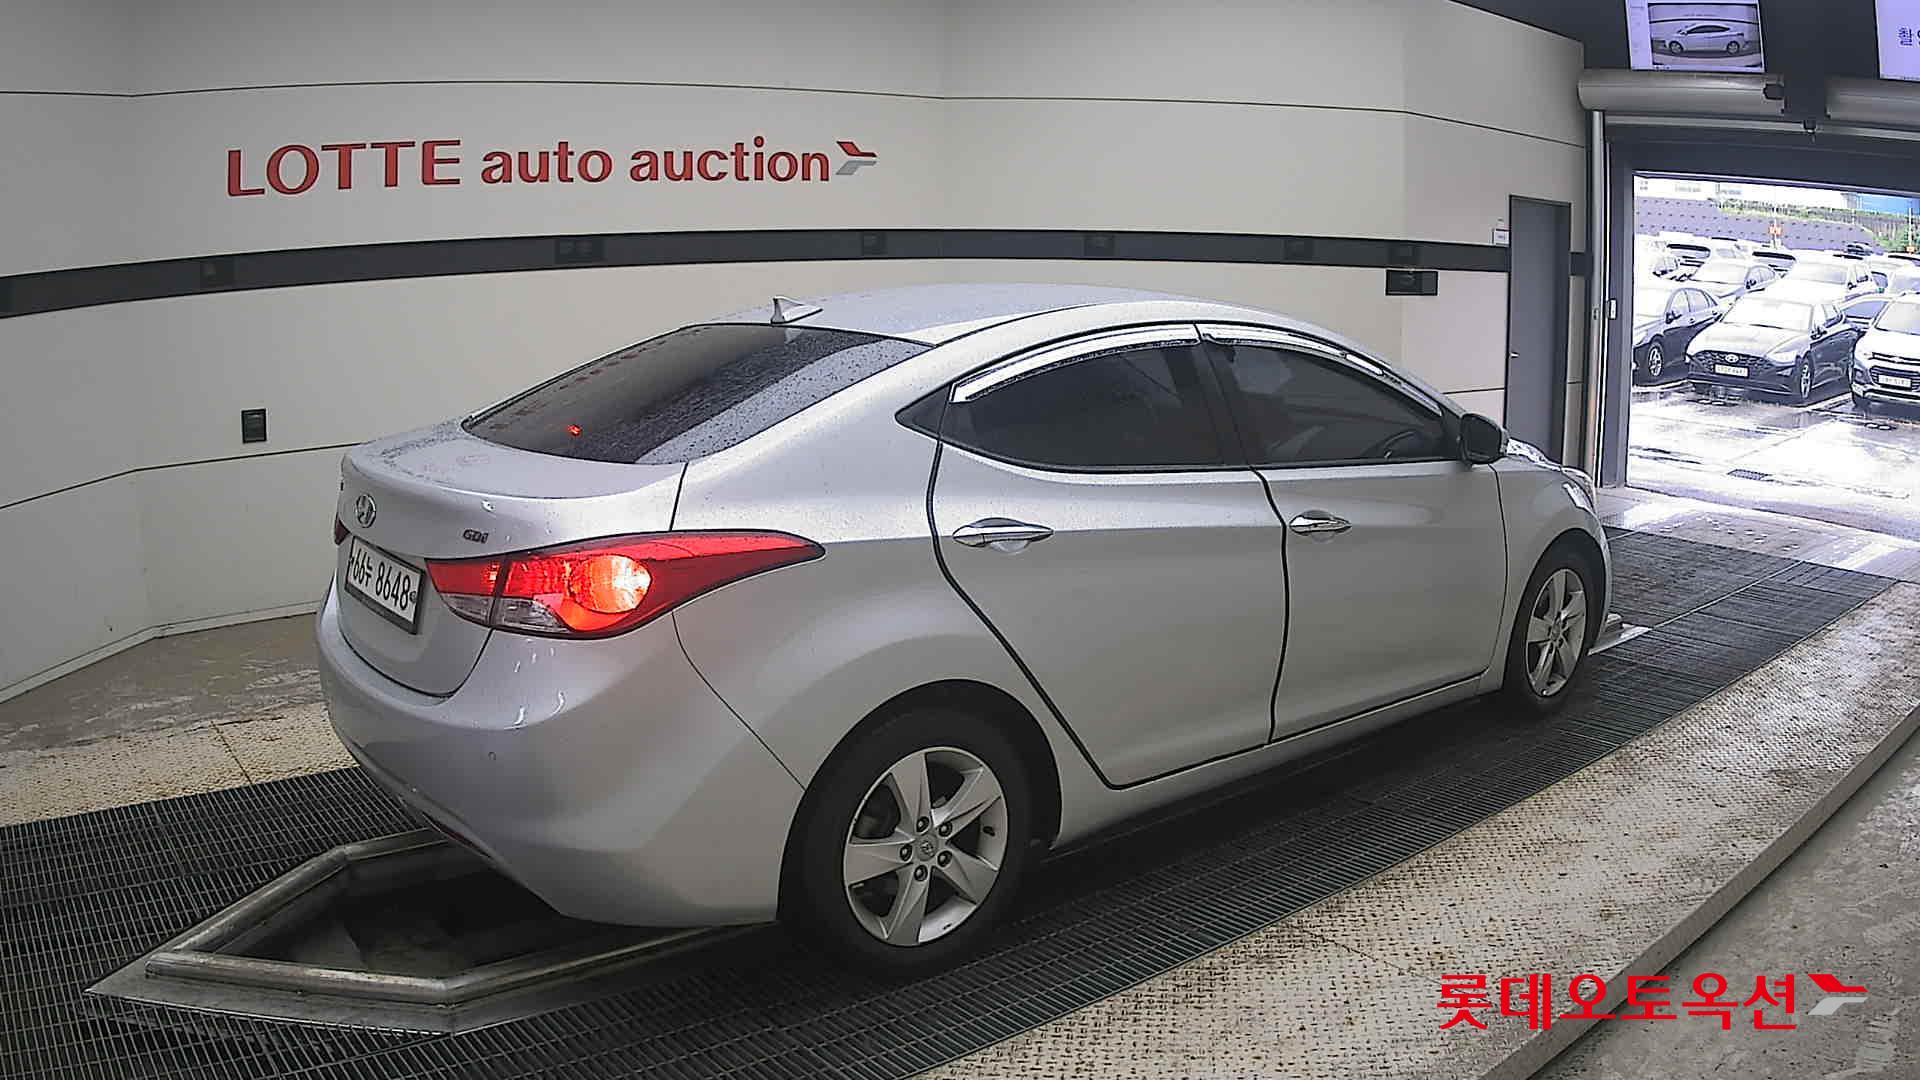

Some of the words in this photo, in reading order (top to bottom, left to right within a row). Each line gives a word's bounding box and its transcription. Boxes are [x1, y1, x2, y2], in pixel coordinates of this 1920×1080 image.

[226, 139, 461, 197] LOTTE
[481, 141, 613, 184] auto
[629, 135, 830, 183] auction
[375, 561, 411, 611] 8648
